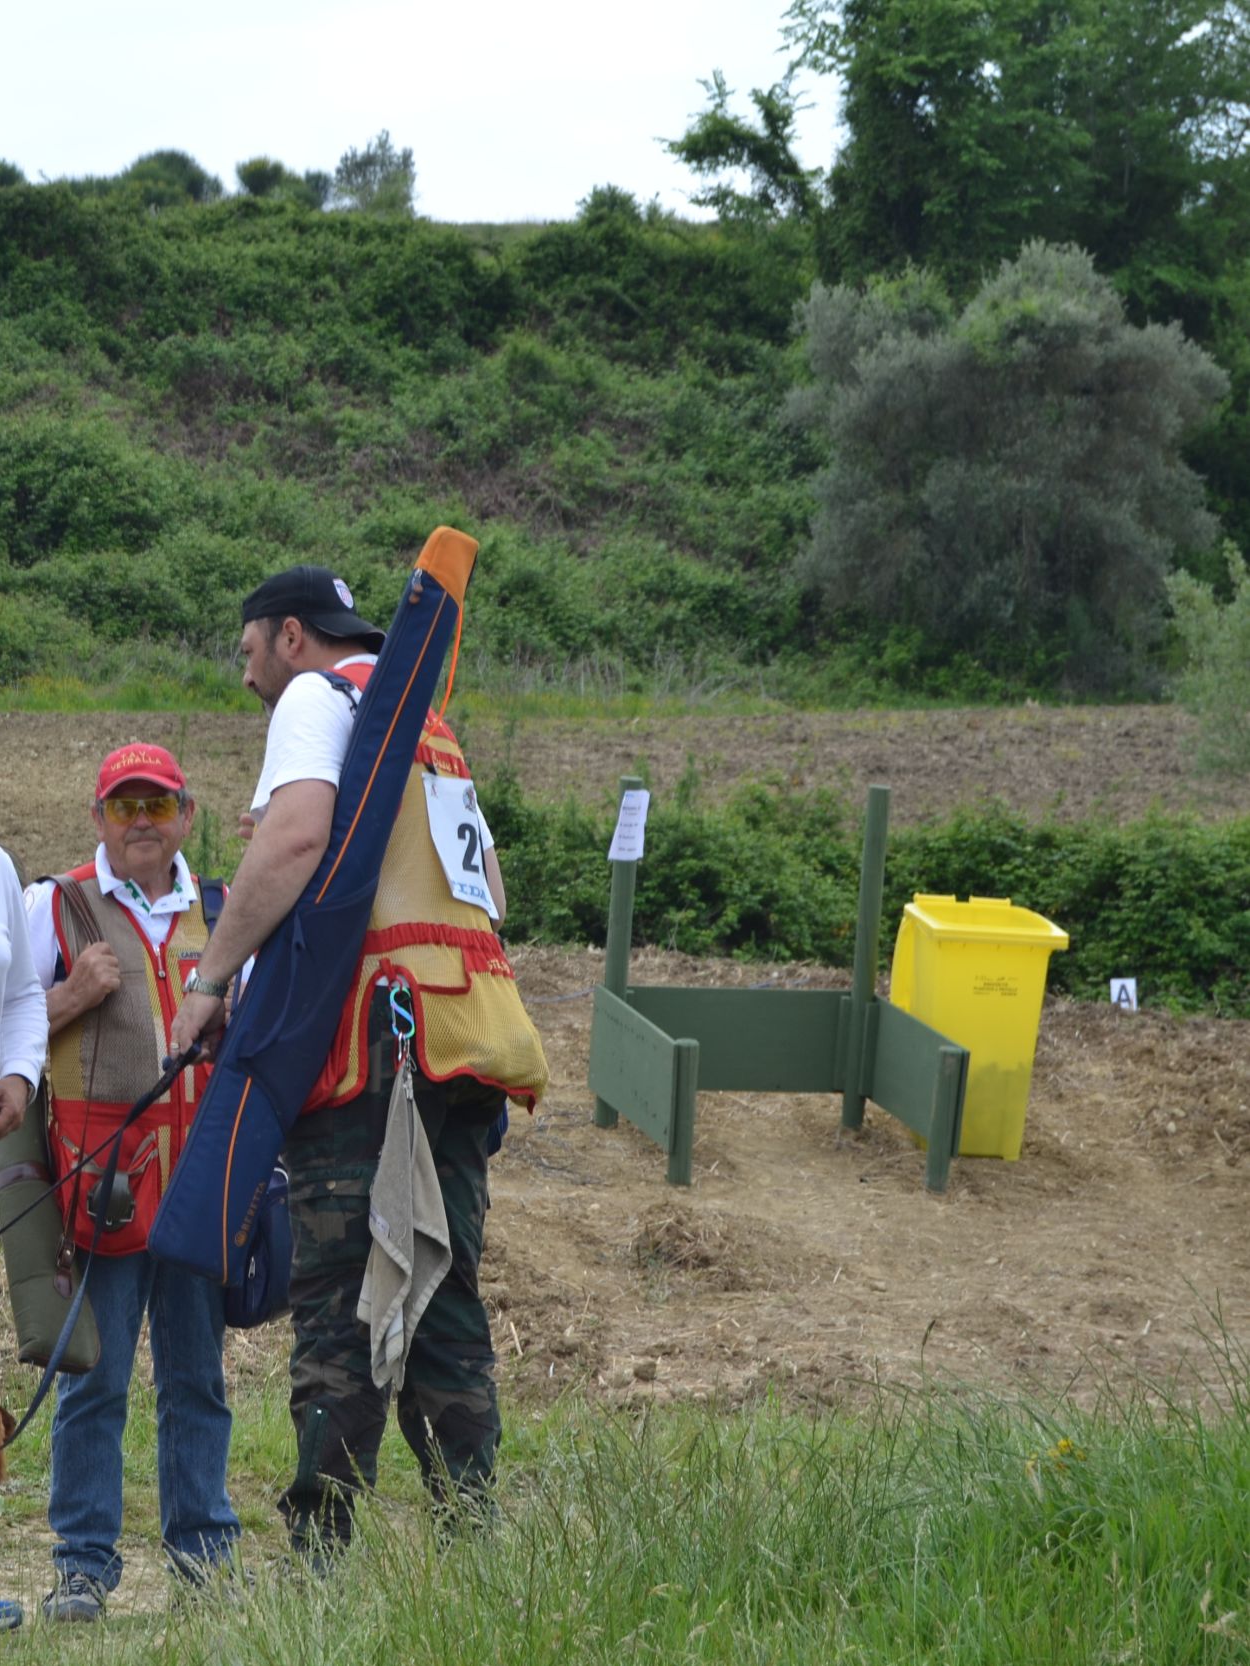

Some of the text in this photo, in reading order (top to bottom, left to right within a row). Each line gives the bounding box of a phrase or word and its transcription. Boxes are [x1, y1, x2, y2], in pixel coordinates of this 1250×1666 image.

[110, 756, 162, 772] VETRALLA
[457, 823, 479, 873] 2
[1116, 984, 1131, 1005] A
[241, 1182, 266, 1233] BERETTA
